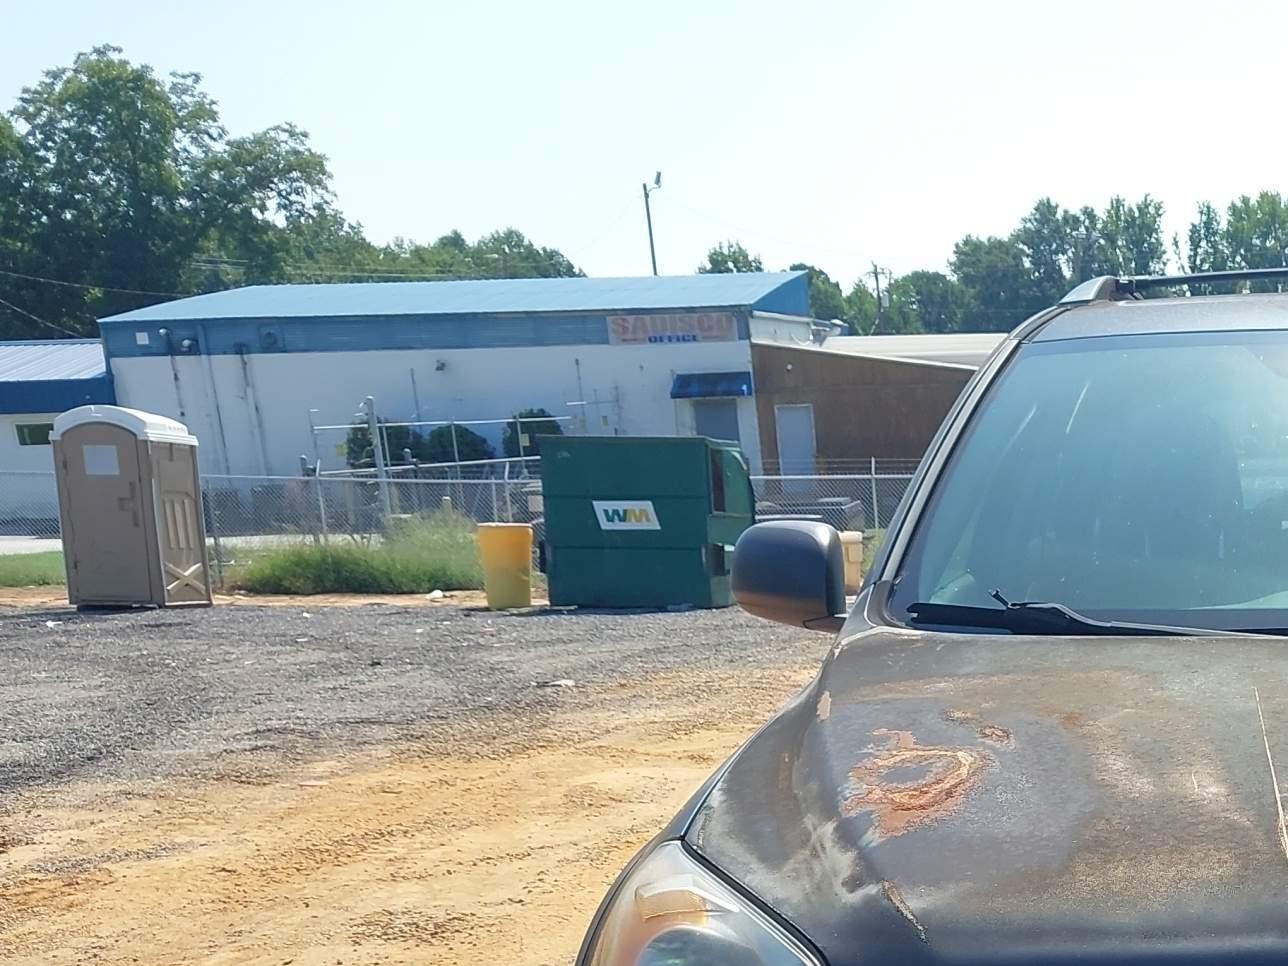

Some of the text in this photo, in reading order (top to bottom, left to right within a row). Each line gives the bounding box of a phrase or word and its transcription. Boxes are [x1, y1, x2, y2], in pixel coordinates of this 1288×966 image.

[612, 313, 734, 336] SADISCO
[648, 334, 698, 344] OFFICE
[602, 508, 651, 523] WM
